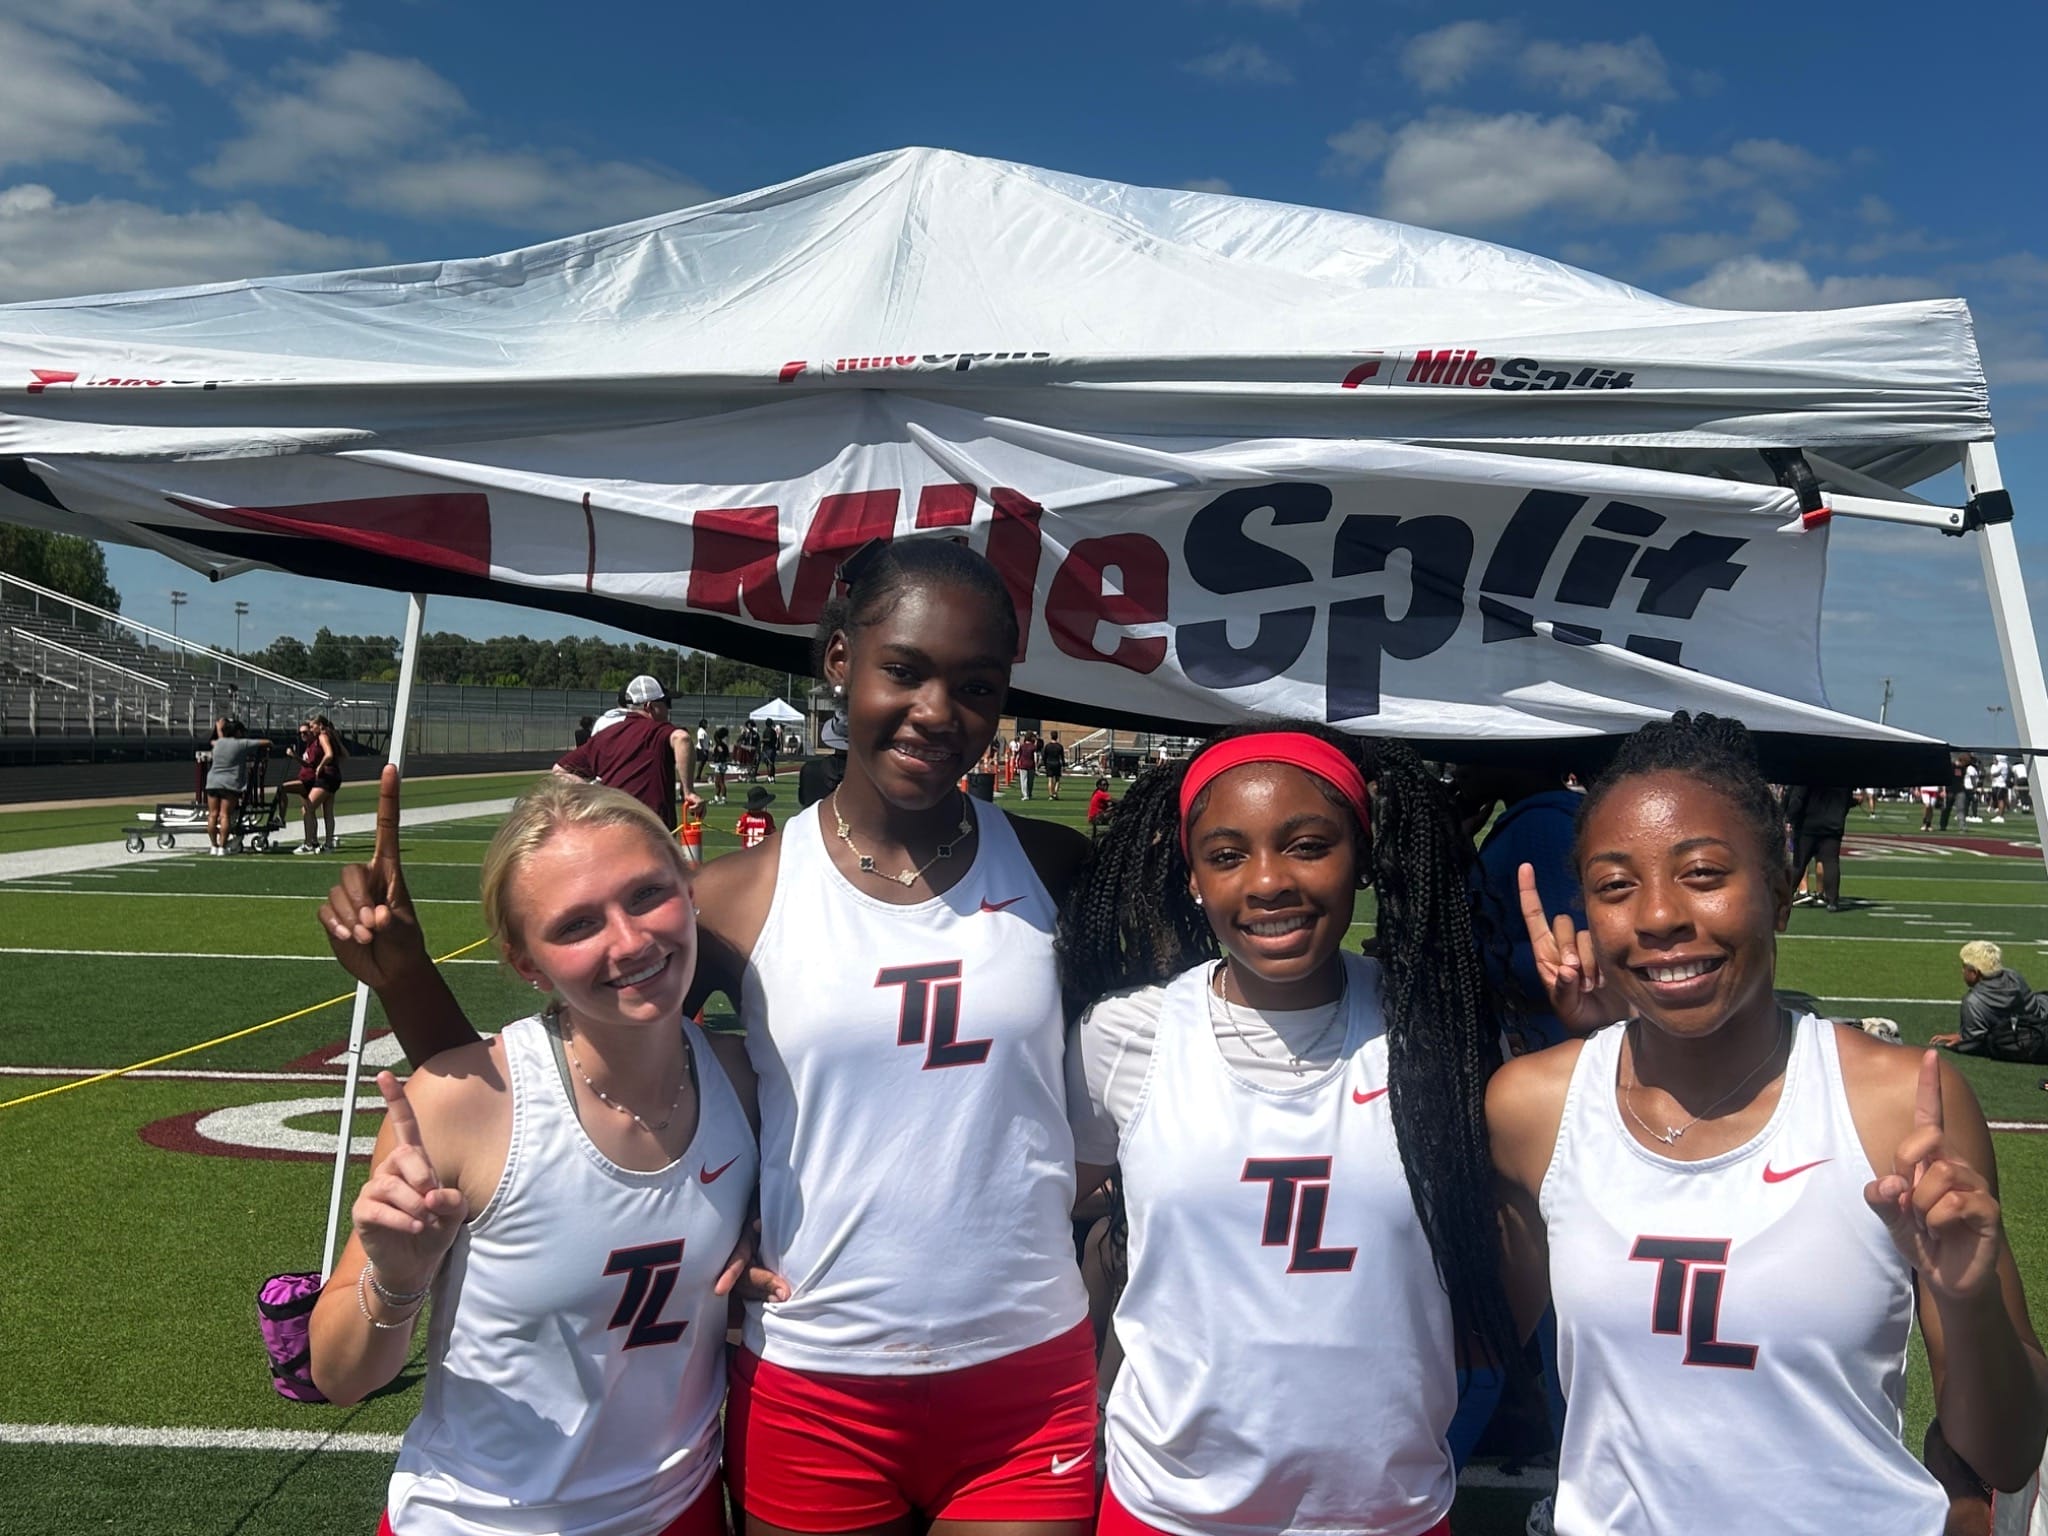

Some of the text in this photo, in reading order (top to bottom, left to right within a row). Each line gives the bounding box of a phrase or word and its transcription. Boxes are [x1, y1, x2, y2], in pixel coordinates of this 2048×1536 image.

[874, 960, 993, 1071] TL
[1240, 1155, 1358, 1274] TL
[602, 1239, 690, 1351] TL
[1629, 1234, 1759, 1370] TL
